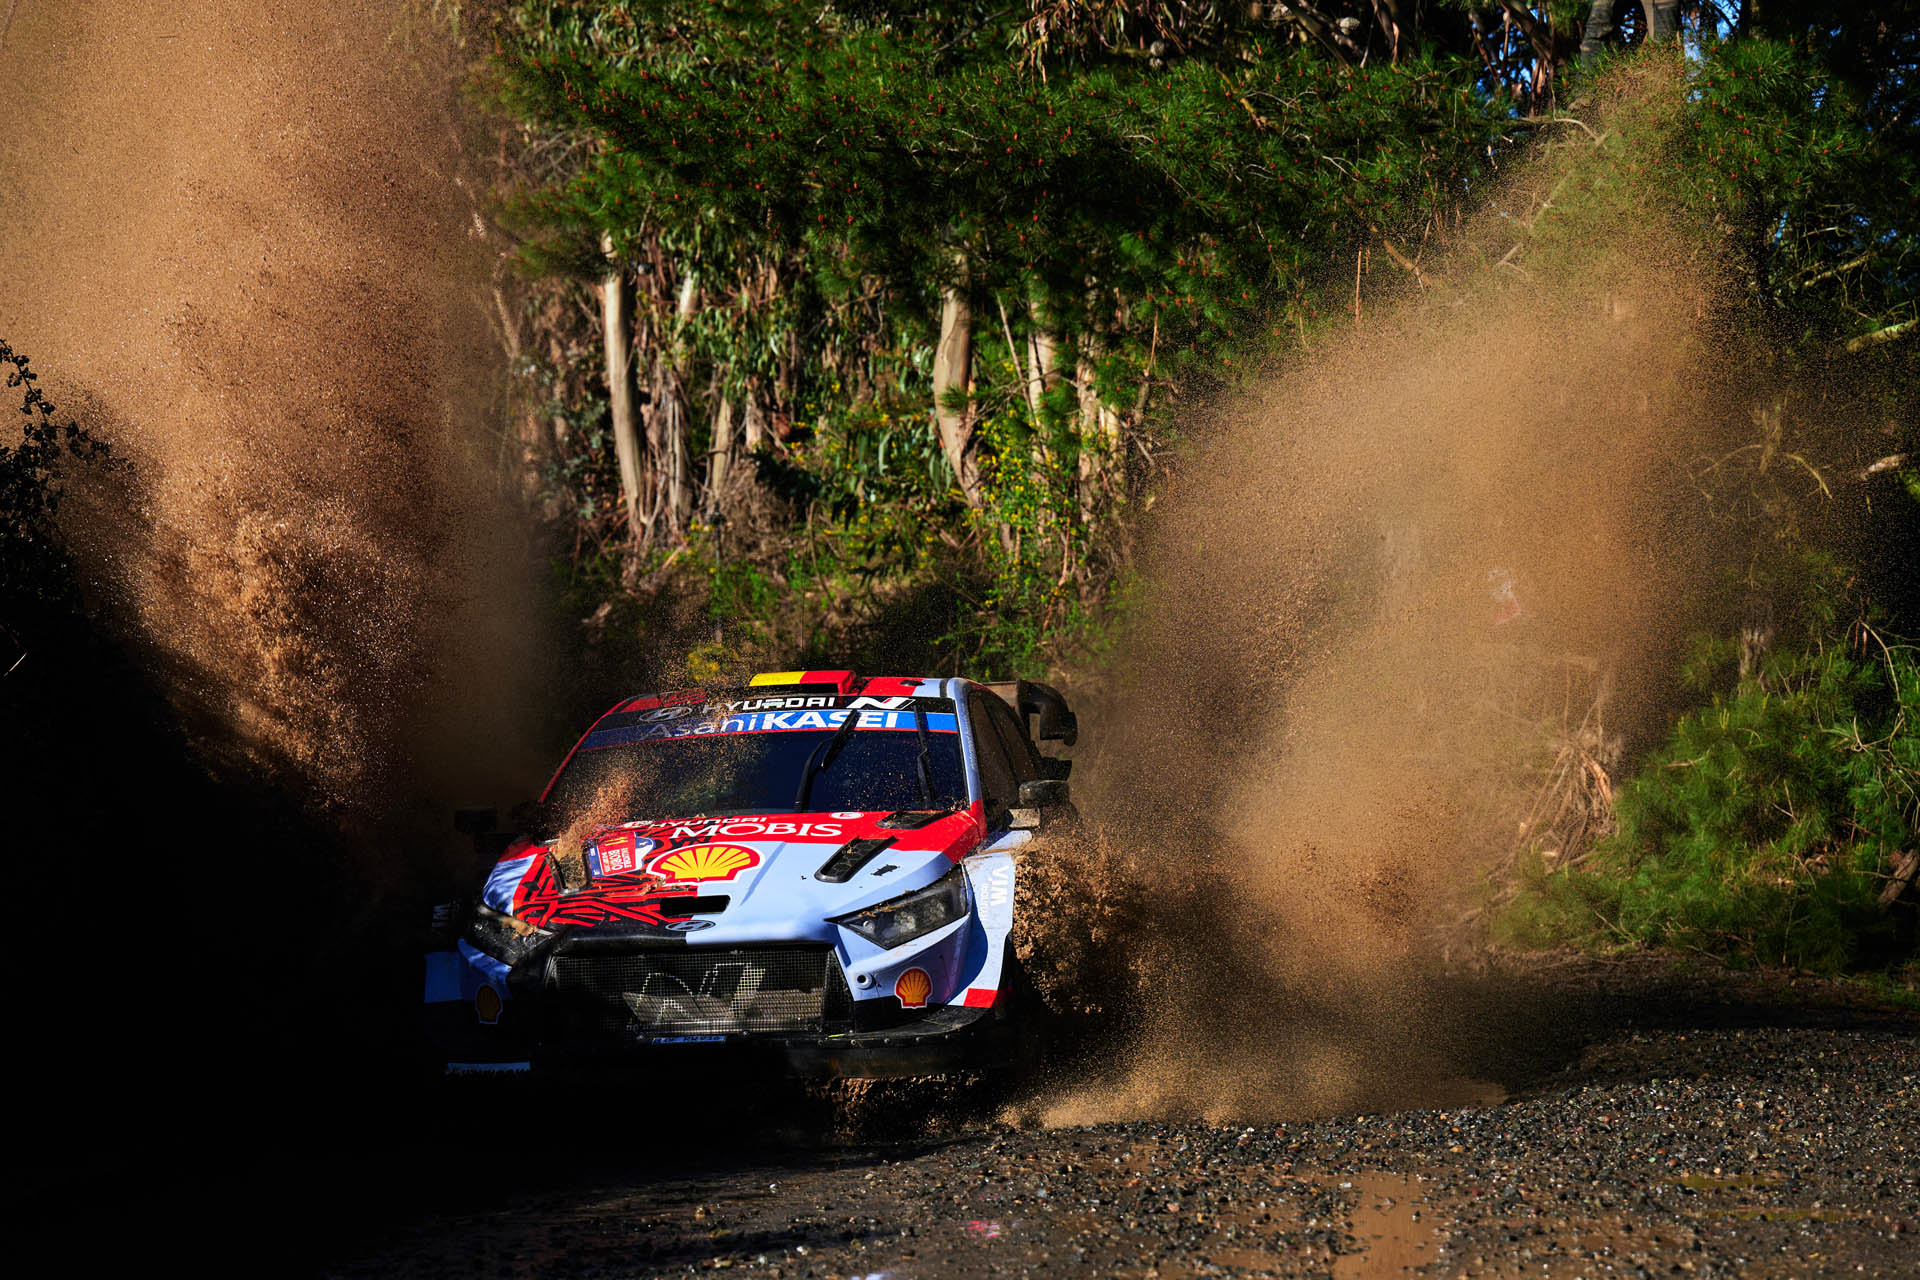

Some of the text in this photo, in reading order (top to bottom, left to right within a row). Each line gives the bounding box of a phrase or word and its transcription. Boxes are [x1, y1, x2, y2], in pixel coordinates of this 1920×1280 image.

[702, 696, 835, 714] HYUNDAI
[648, 816, 768, 829] HYUNDAI
[668, 822, 842, 839] MOBIS
